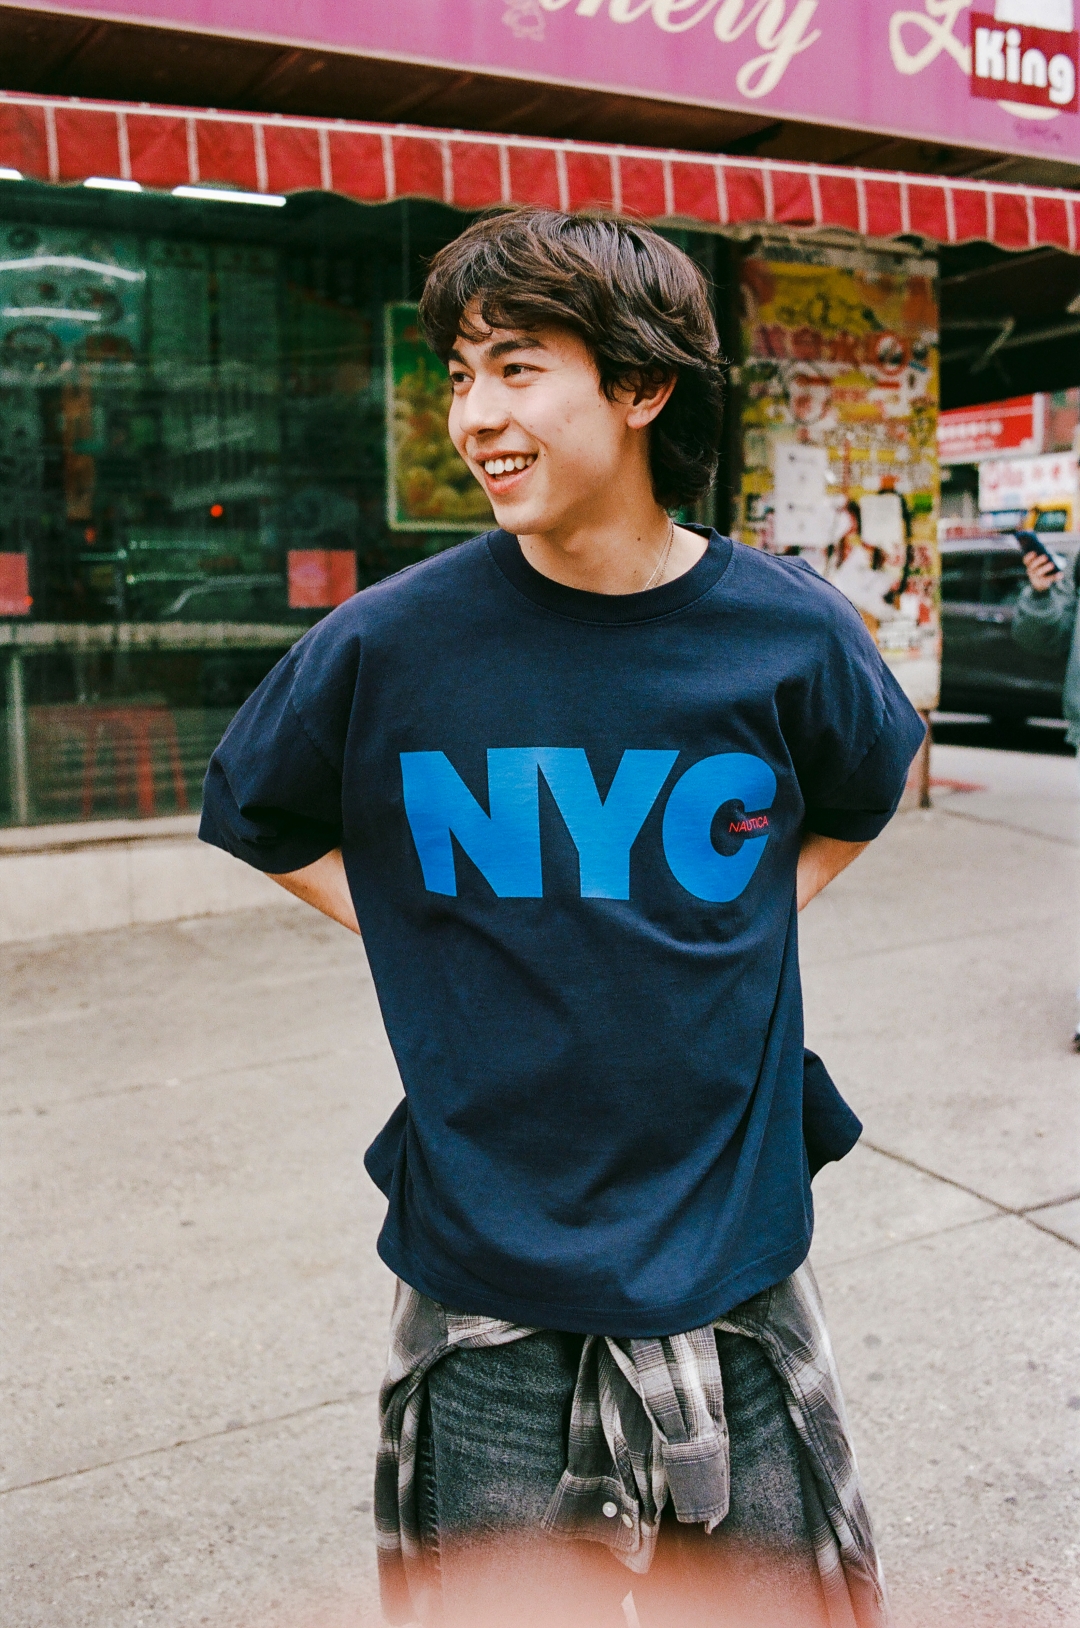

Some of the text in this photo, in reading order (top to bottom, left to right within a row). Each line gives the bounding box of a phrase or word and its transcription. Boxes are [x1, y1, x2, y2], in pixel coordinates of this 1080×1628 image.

[975, 27, 1075, 104] King
[400, 746, 777, 903] NYC
[728, 815, 769, 833] NAUTICA
